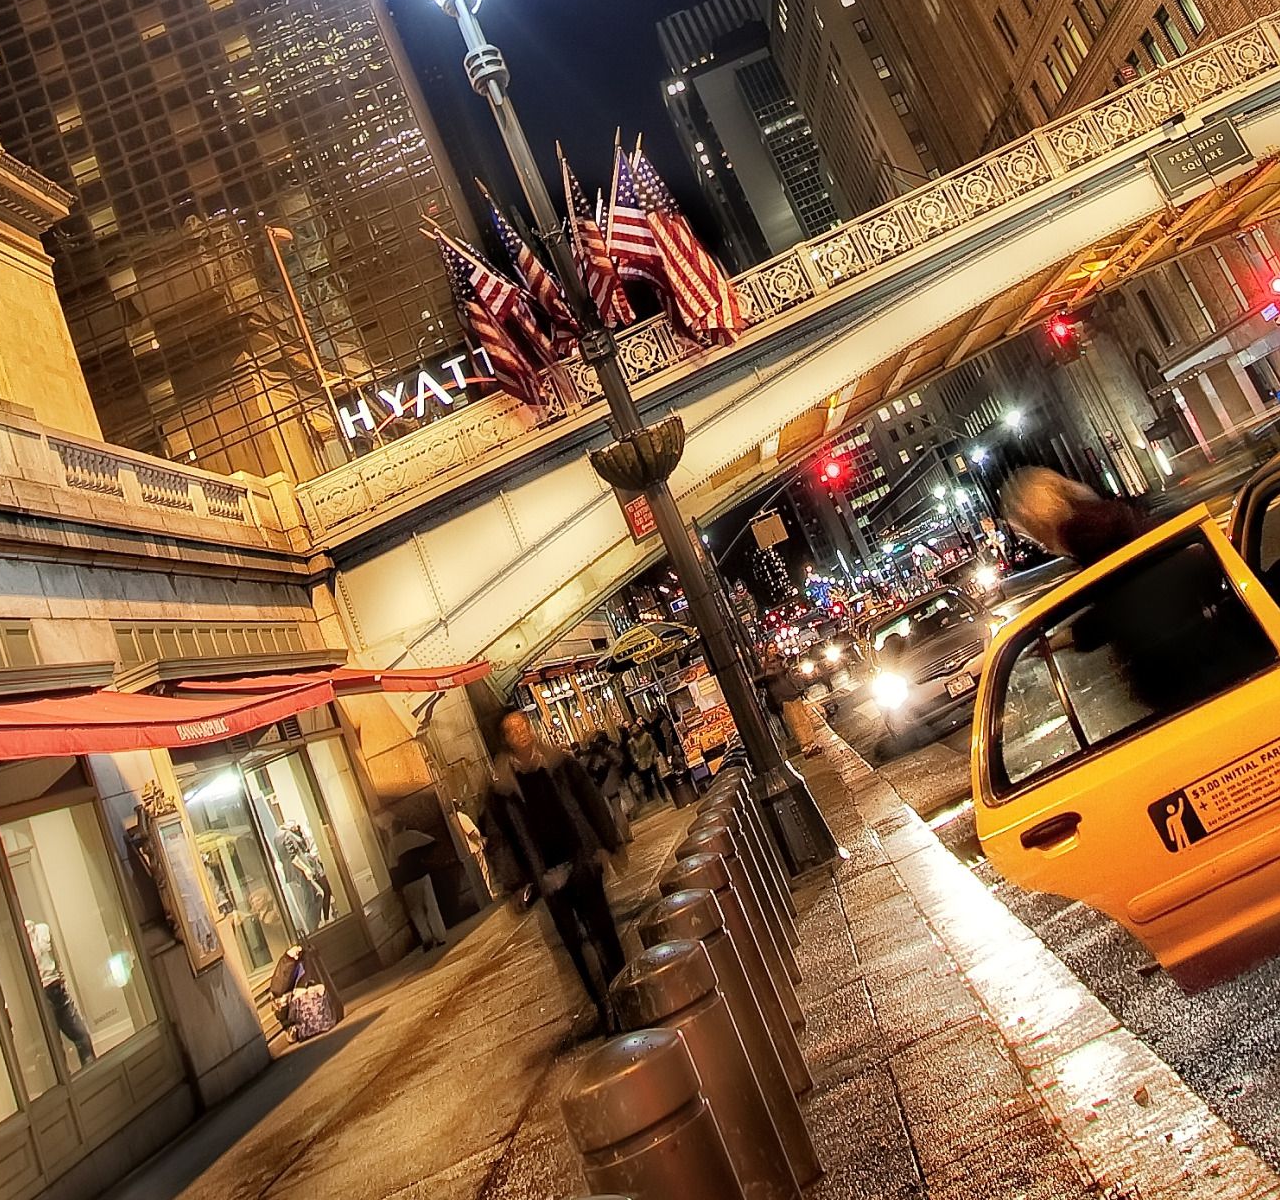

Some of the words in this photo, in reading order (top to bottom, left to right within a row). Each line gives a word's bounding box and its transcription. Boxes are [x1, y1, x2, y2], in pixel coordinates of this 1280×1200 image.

[1168, 132, 1225, 166] PERSHING
[1181, 147, 1225, 175] SQUARE
[339, 346, 495, 439] HYATT
[1221, 760, 1259, 784] INITIAL
